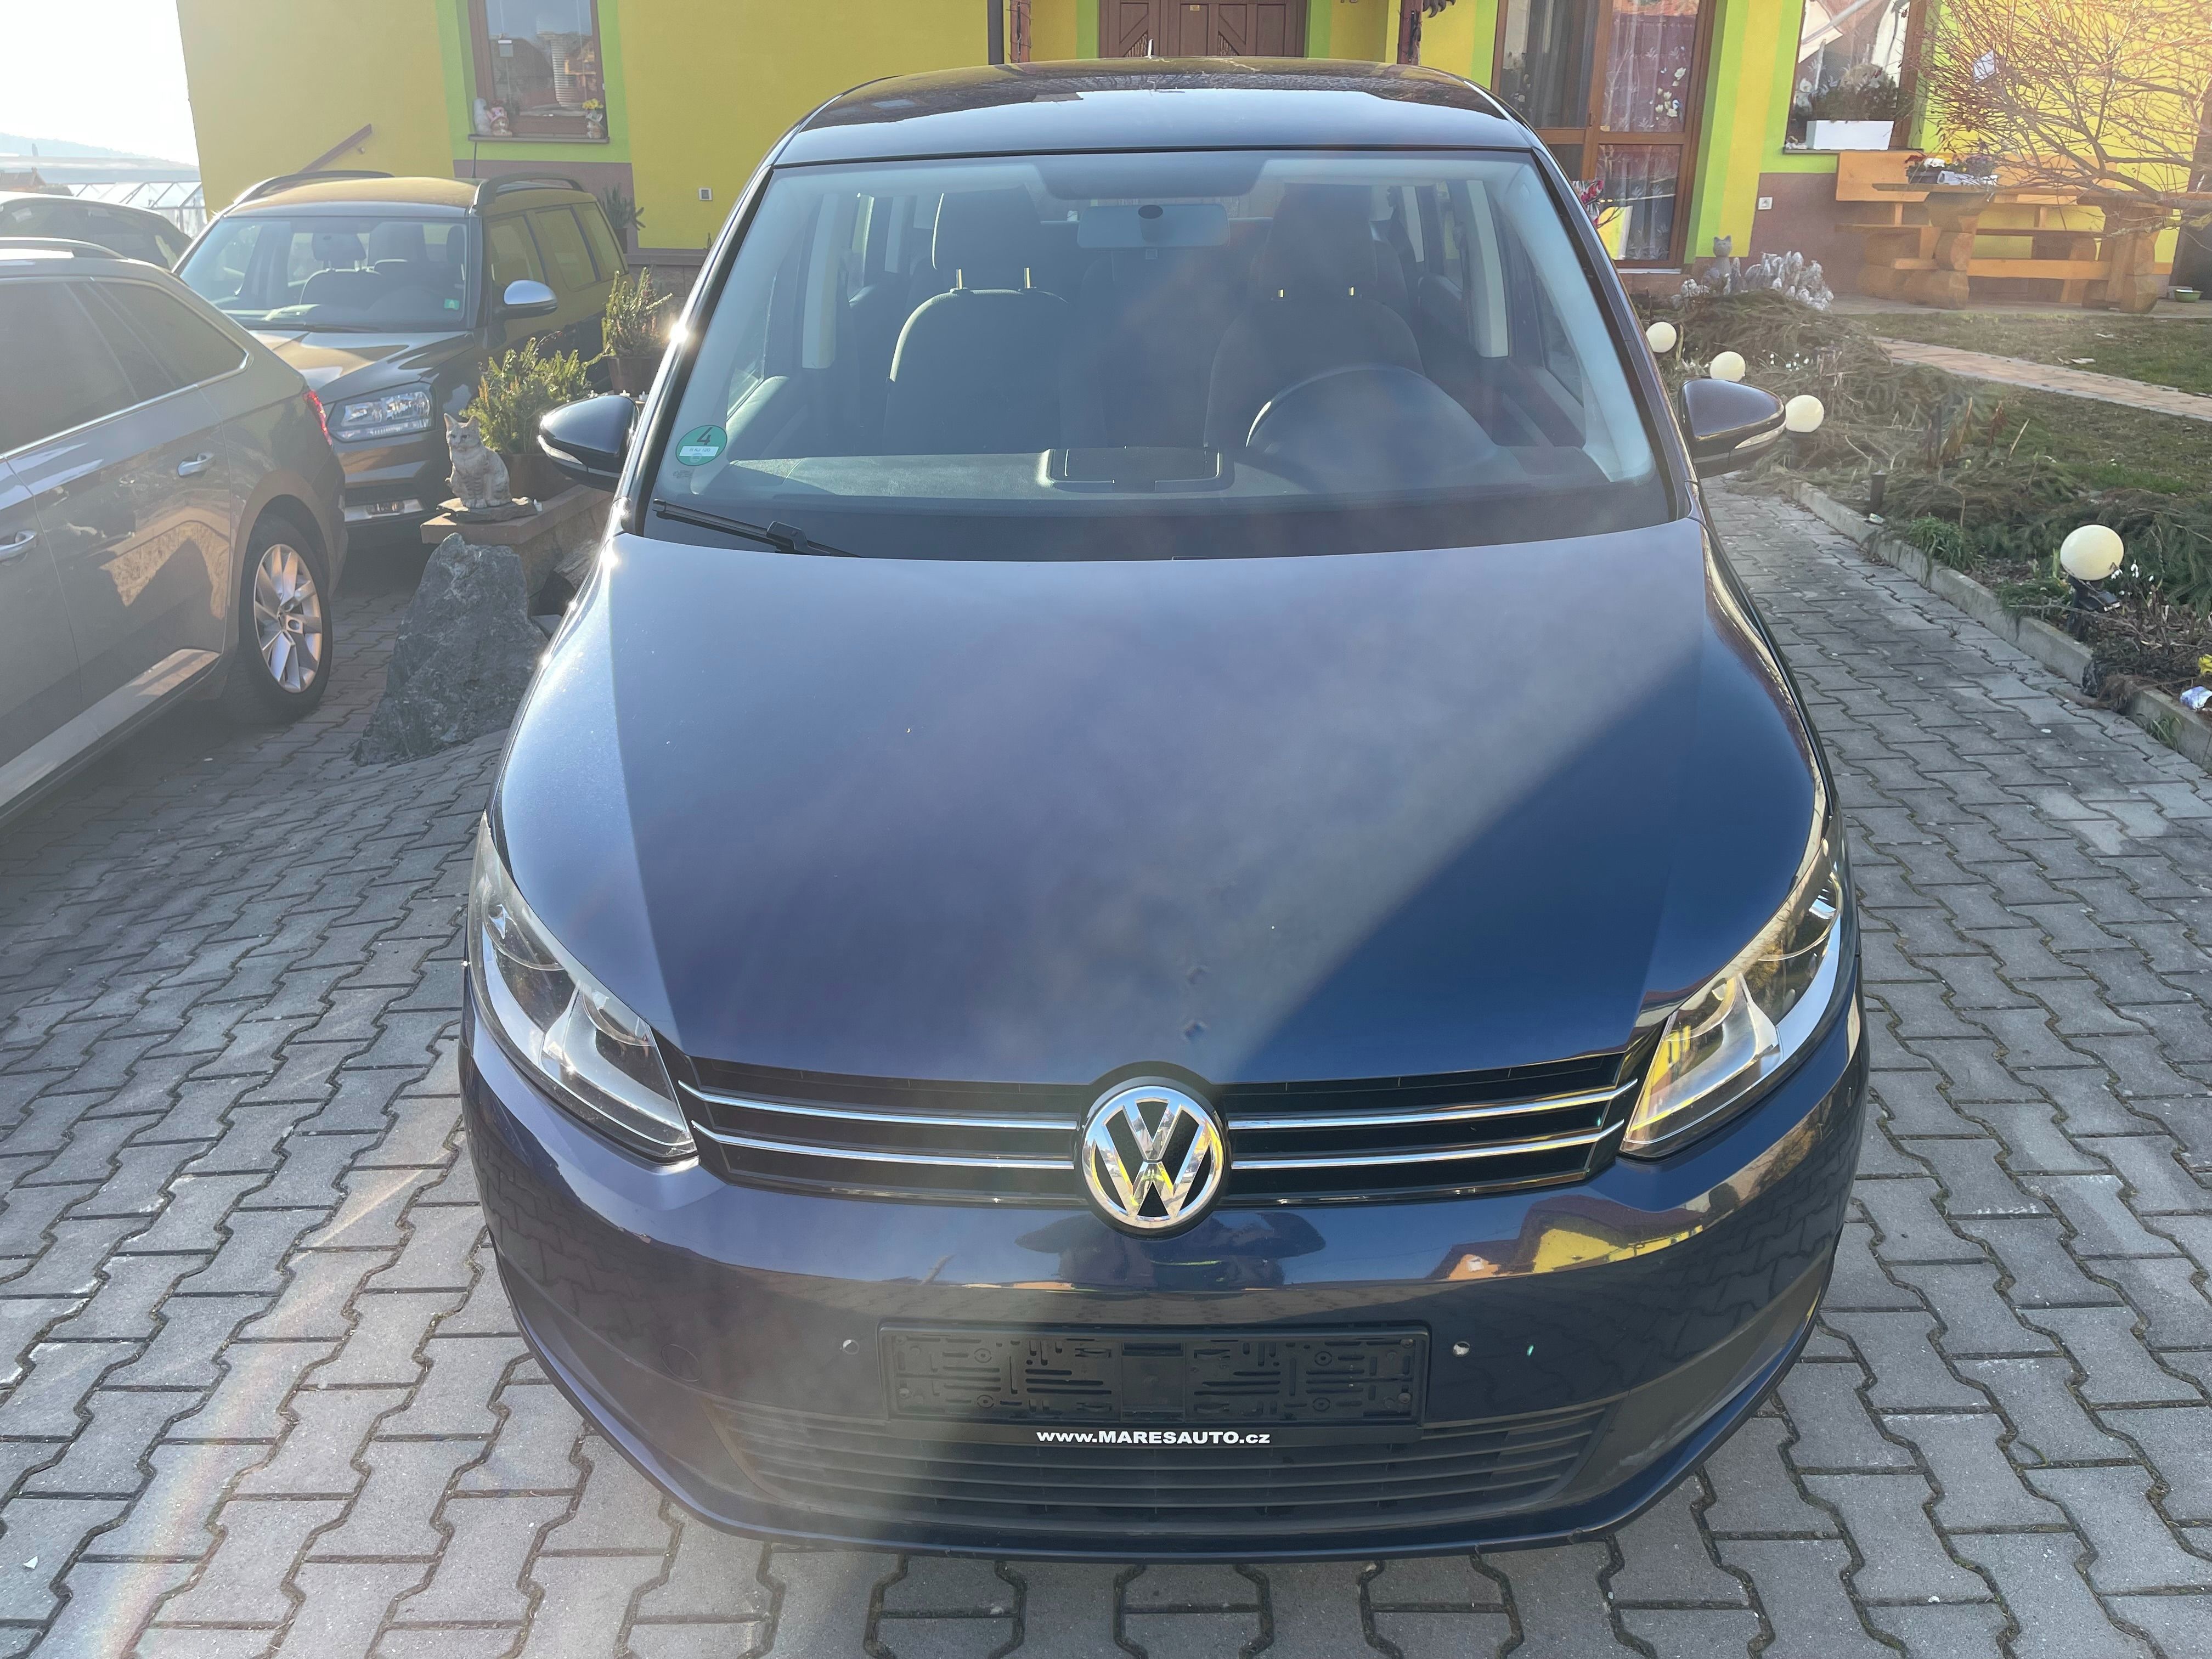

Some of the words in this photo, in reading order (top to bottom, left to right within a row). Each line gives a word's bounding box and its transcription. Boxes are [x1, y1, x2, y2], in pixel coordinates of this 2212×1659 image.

[697, 427, 713, 445] 4
[1084, 1088, 1221, 1224] VW
[1036, 1431, 1271, 1444] www.MARESAUTO.cz
